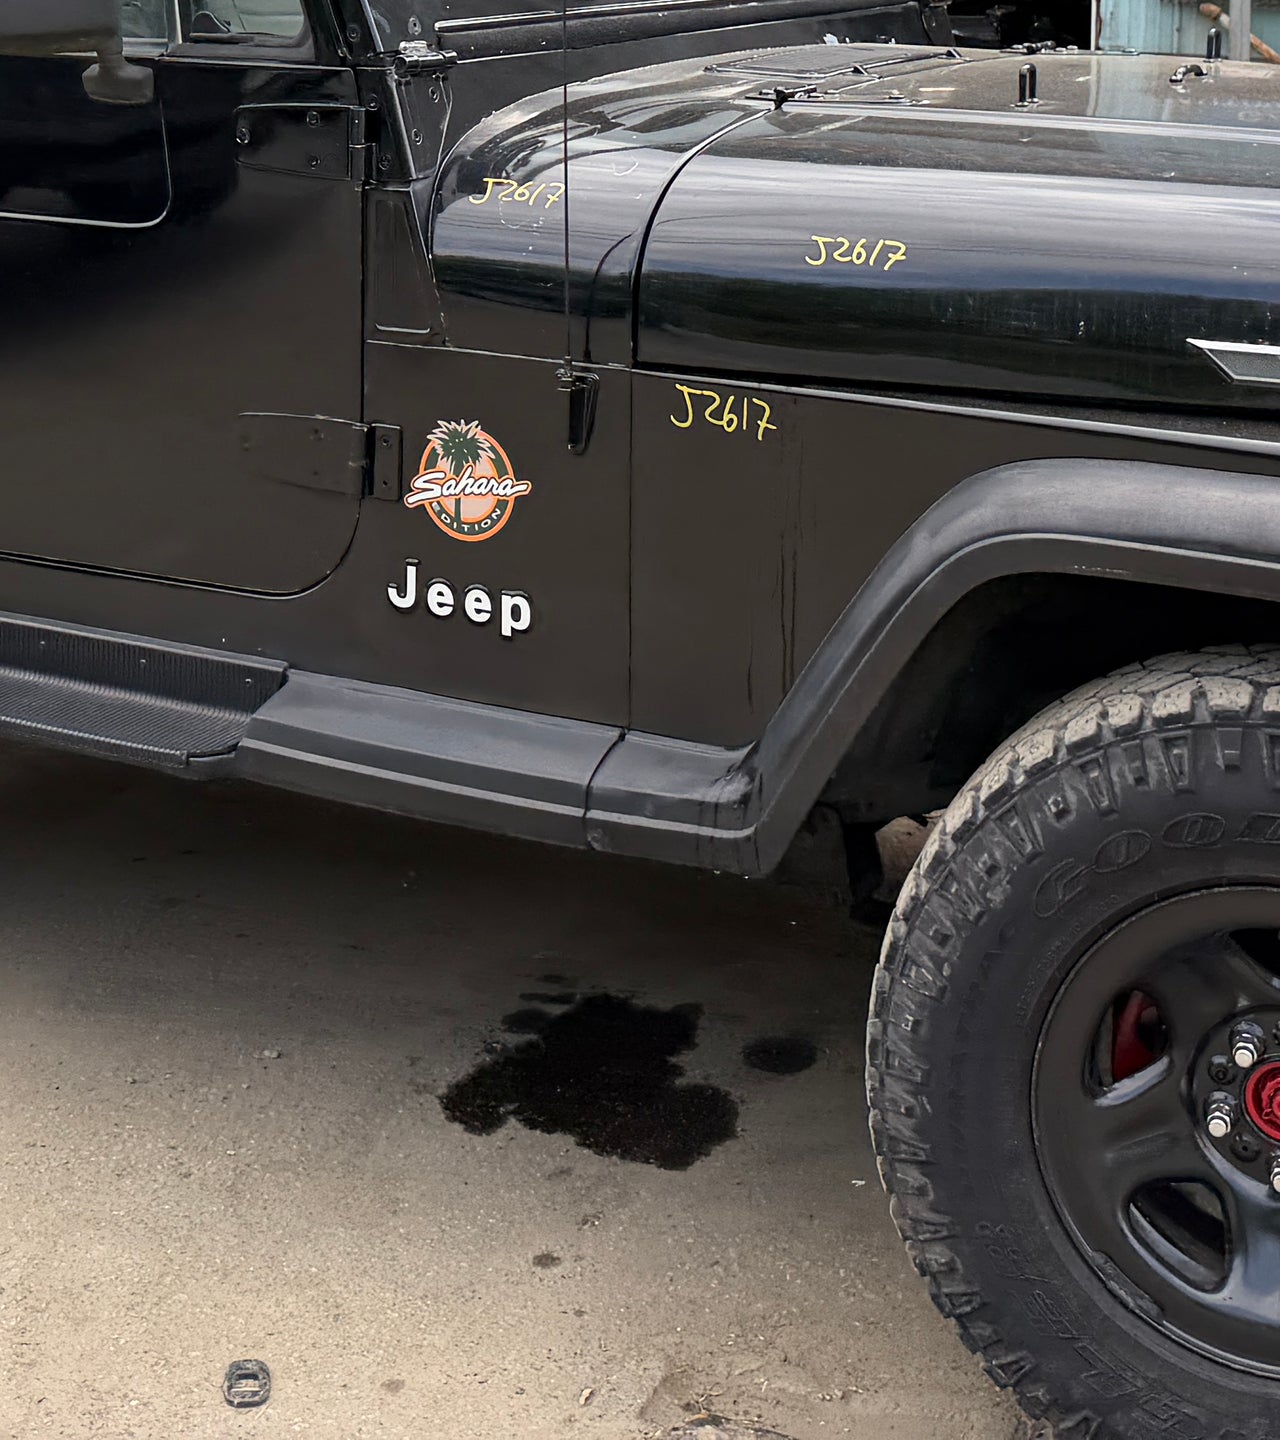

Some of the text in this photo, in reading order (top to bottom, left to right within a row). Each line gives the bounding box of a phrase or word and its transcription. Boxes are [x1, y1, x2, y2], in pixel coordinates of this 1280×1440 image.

[469, 177, 566, 209] J2617
[805, 234, 907, 270] J2617
[670, 384, 777, 441] J2617
[407, 464, 529, 505] Sahara
[432, 501, 501, 532] EDITION
[387, 558, 532, 637] Jeep
